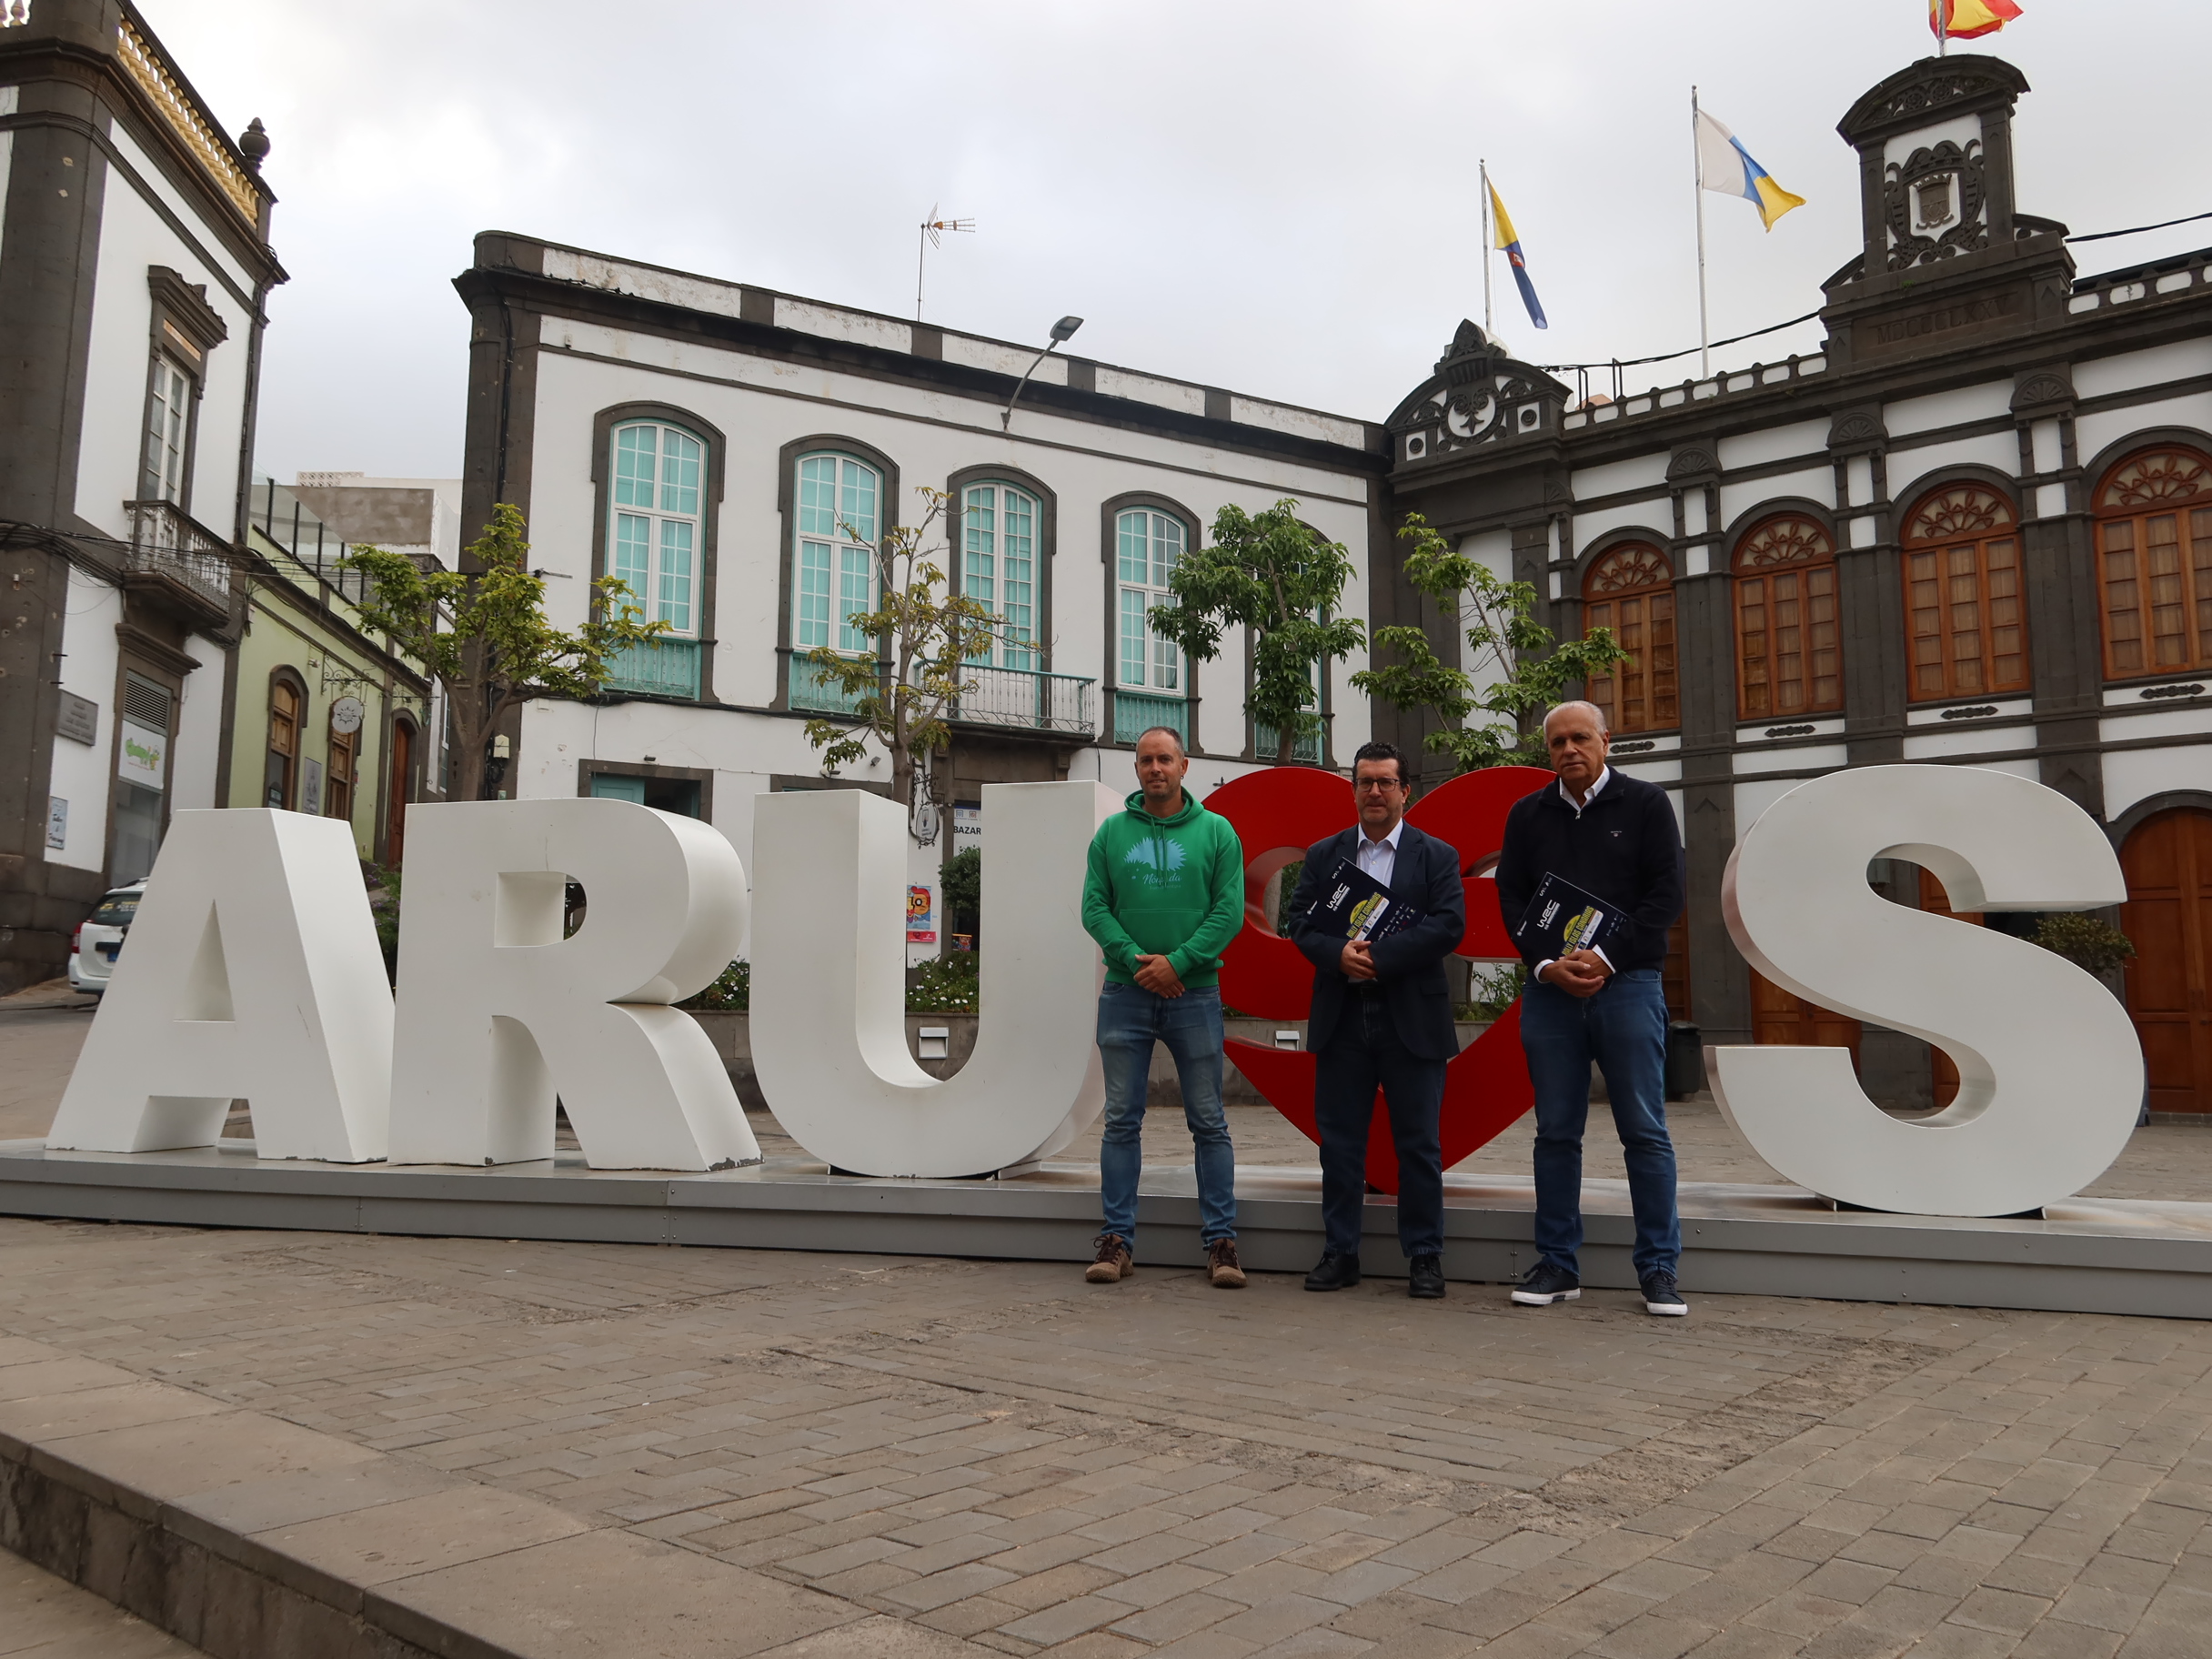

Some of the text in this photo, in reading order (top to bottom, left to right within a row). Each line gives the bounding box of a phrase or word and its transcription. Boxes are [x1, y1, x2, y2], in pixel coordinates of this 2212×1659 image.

[953, 825, 981, 835] BAZAR
[1326, 882, 1347, 909] WRC
[1537, 900, 1556, 928] WRC
